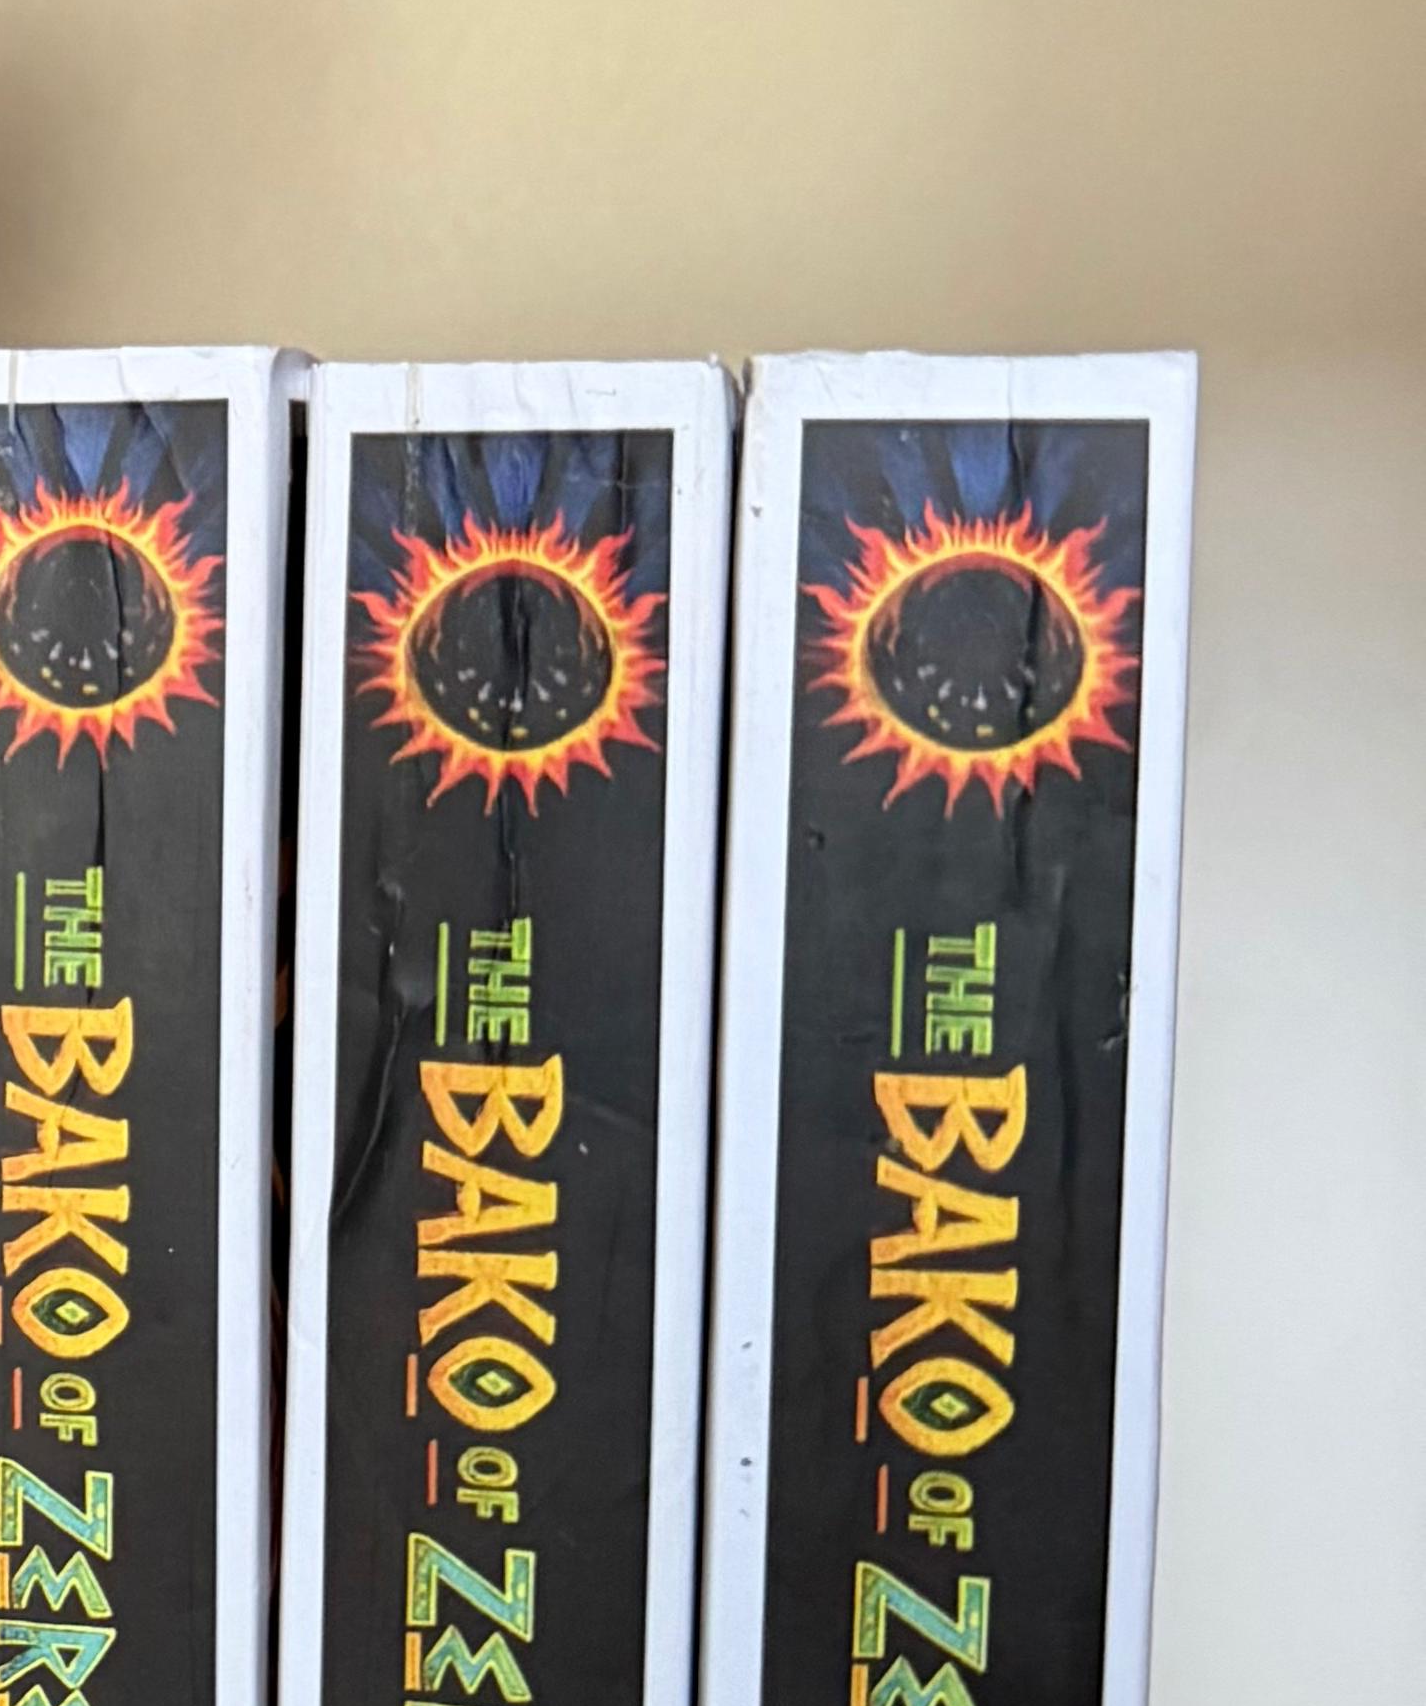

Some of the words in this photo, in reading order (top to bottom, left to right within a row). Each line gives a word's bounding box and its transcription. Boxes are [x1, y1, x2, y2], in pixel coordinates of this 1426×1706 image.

[43, 867, 103, 988] THE
[468, 917, 531, 1044] THE
[926, 922, 996, 1055] THE
[1, 996, 134, 1359] BAKO
[417, 1054, 563, 1431] BAKO
[870, 1064, 1027, 1455] BAKO
[40, 1373, 97, 1446] OF
[457, 1447, 519, 1522] OF
[909, 1473, 973, 1549] OF
